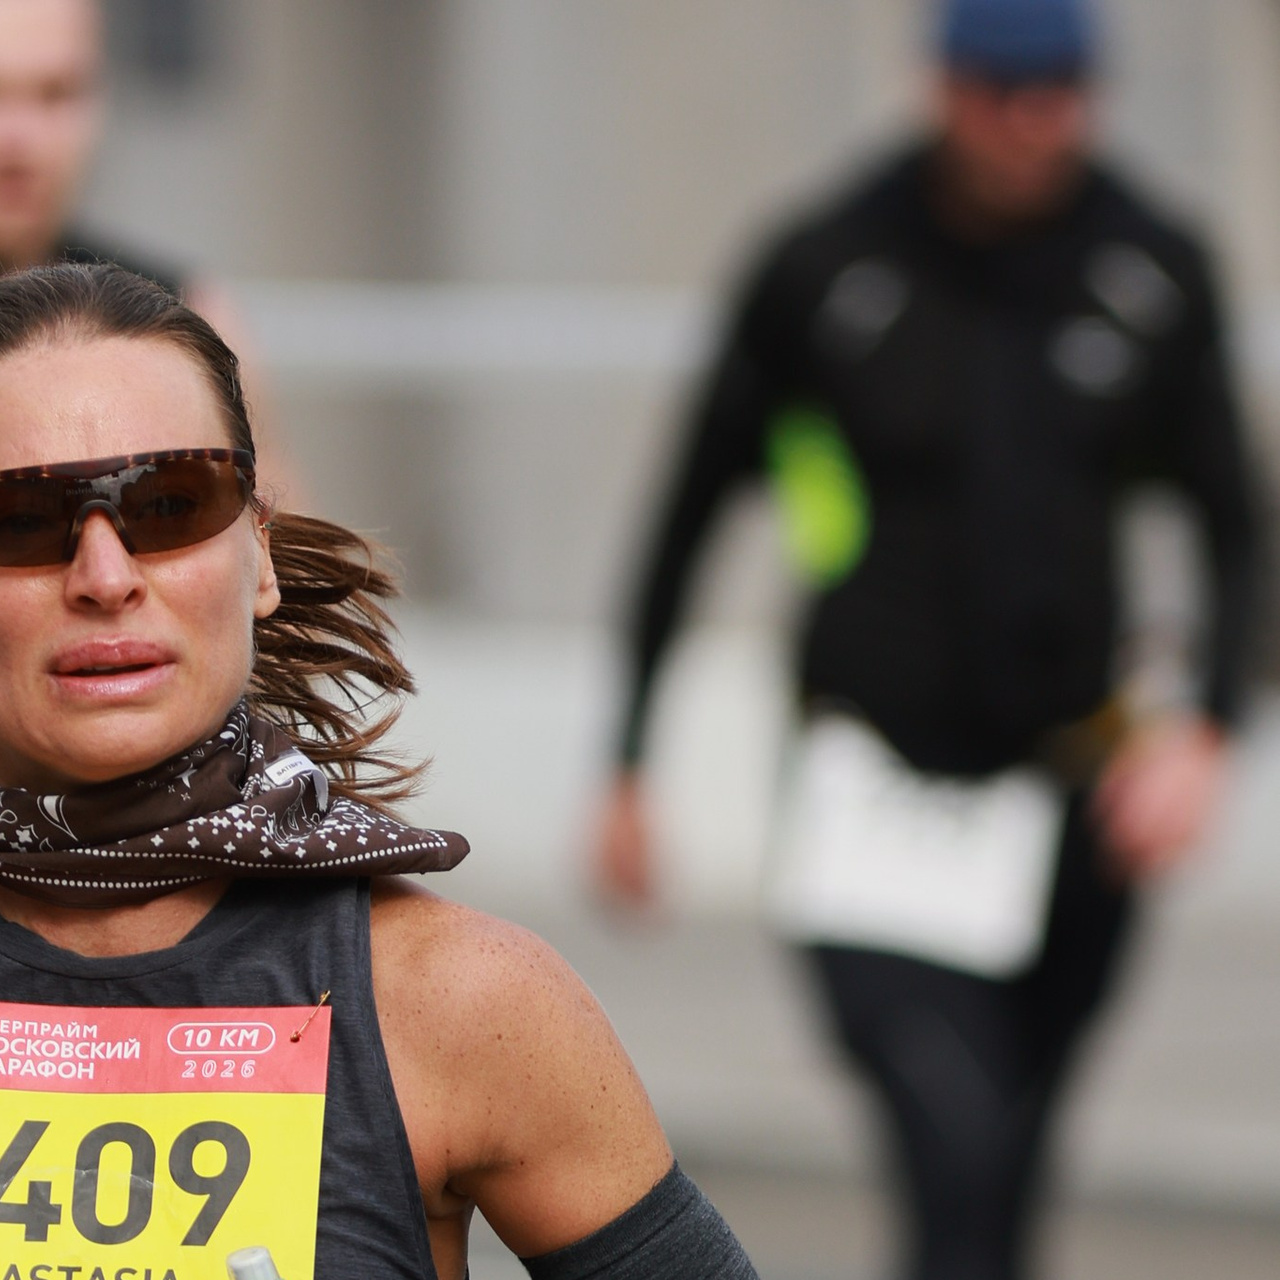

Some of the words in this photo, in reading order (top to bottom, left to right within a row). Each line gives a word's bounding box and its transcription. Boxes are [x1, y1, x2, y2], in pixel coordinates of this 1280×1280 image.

[276, 760, 303, 776] SATISFY
[184, 1028, 212, 1048] 10
[219, 1028, 259, 1048] KM
[181, 1059, 256, 1078] 2026
